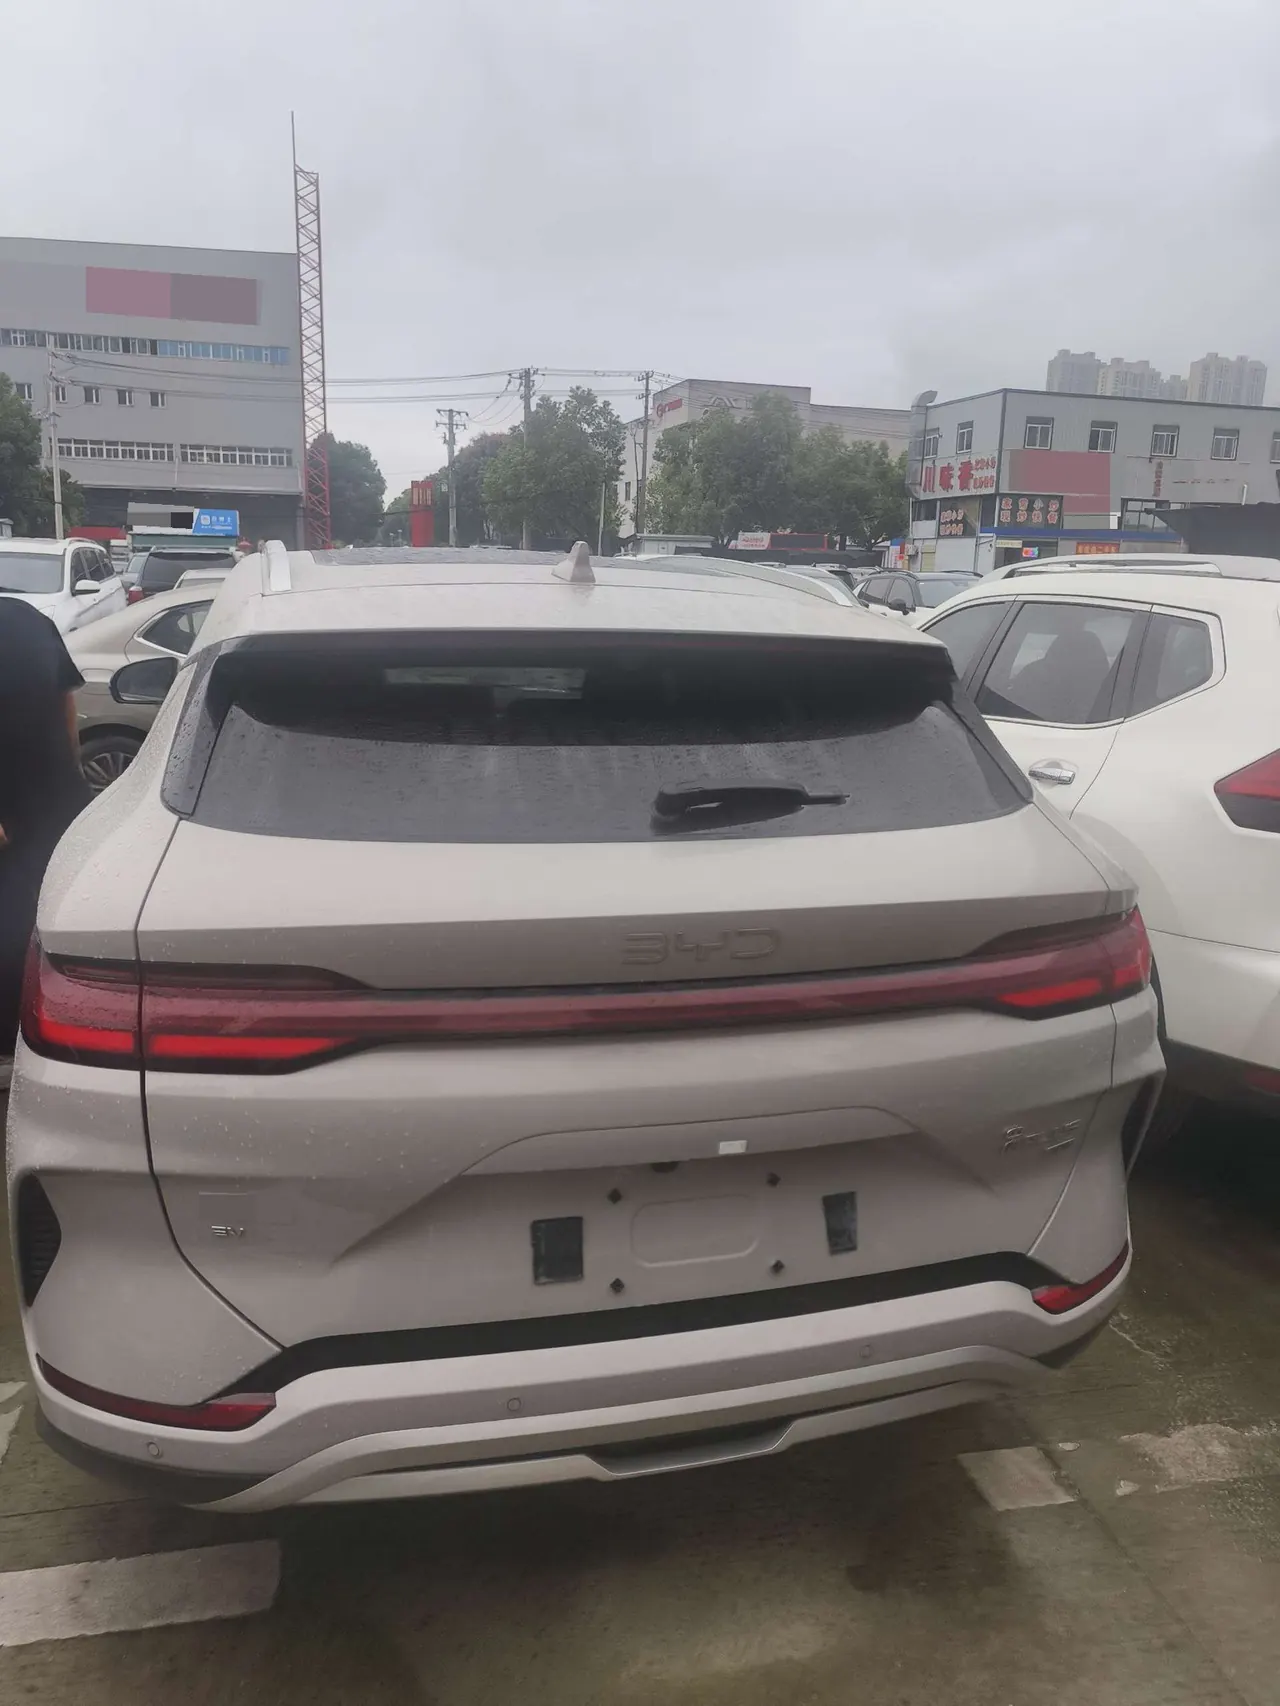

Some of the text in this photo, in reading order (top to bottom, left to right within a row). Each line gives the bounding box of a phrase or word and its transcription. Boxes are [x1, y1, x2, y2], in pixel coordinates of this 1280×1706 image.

[923, 461, 973, 492] 川味香
[622, 928, 780, 965] BYD
